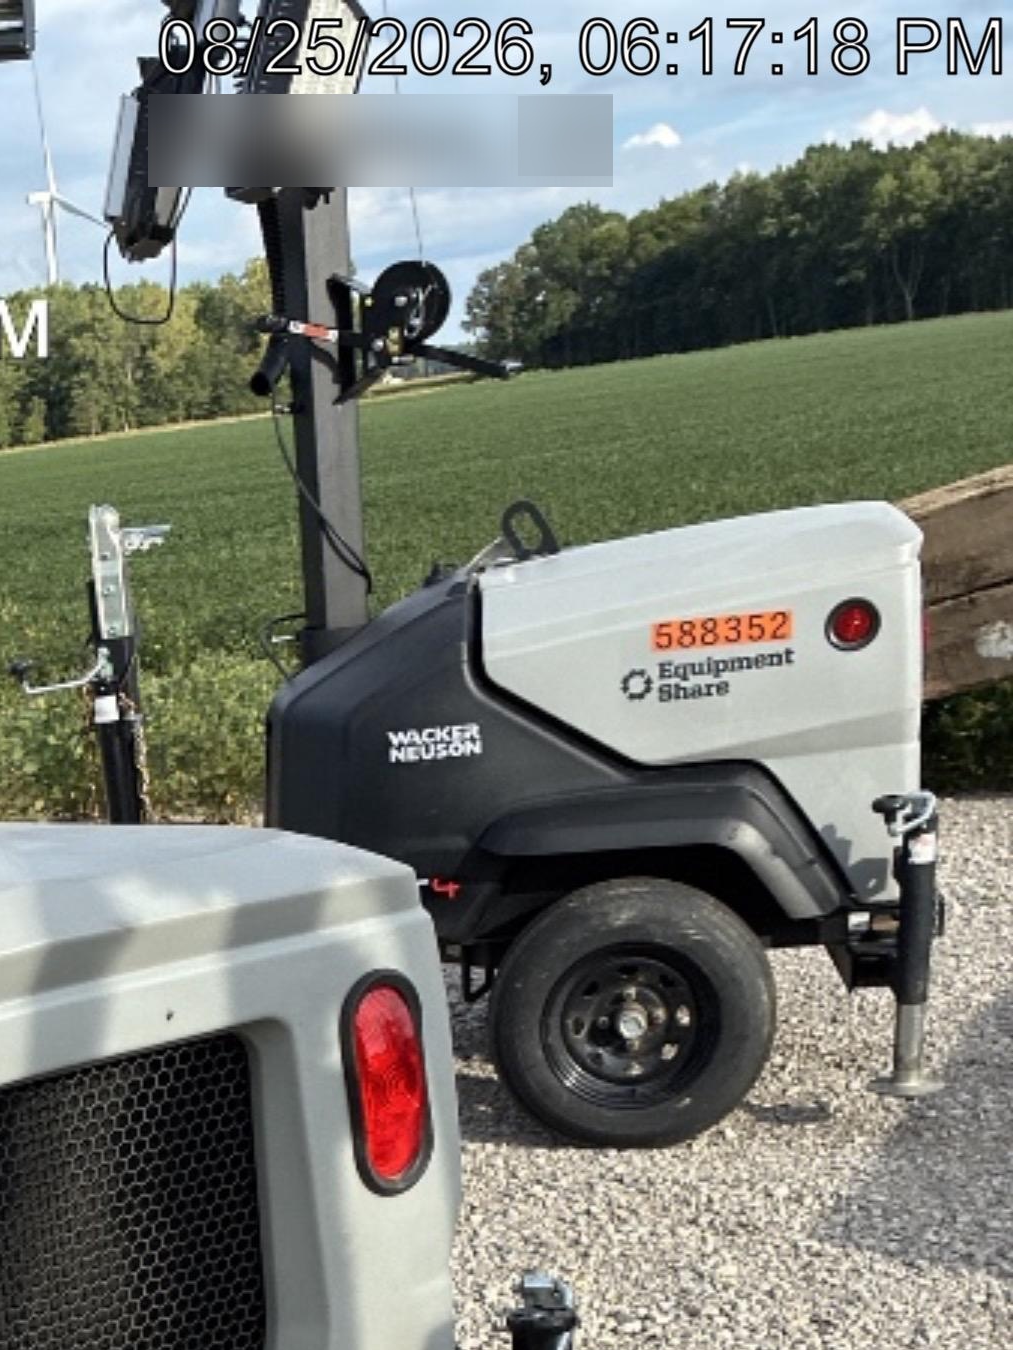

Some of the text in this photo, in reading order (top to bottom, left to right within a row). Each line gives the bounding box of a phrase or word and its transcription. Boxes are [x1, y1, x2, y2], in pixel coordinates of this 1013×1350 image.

[655, 611, 789, 650] 588352
[657, 647, 795, 681] Equipment
[657, 680, 730, 703] Share
[385, 722, 480, 746] WACKER
[389, 739, 483, 763] NEUSON
